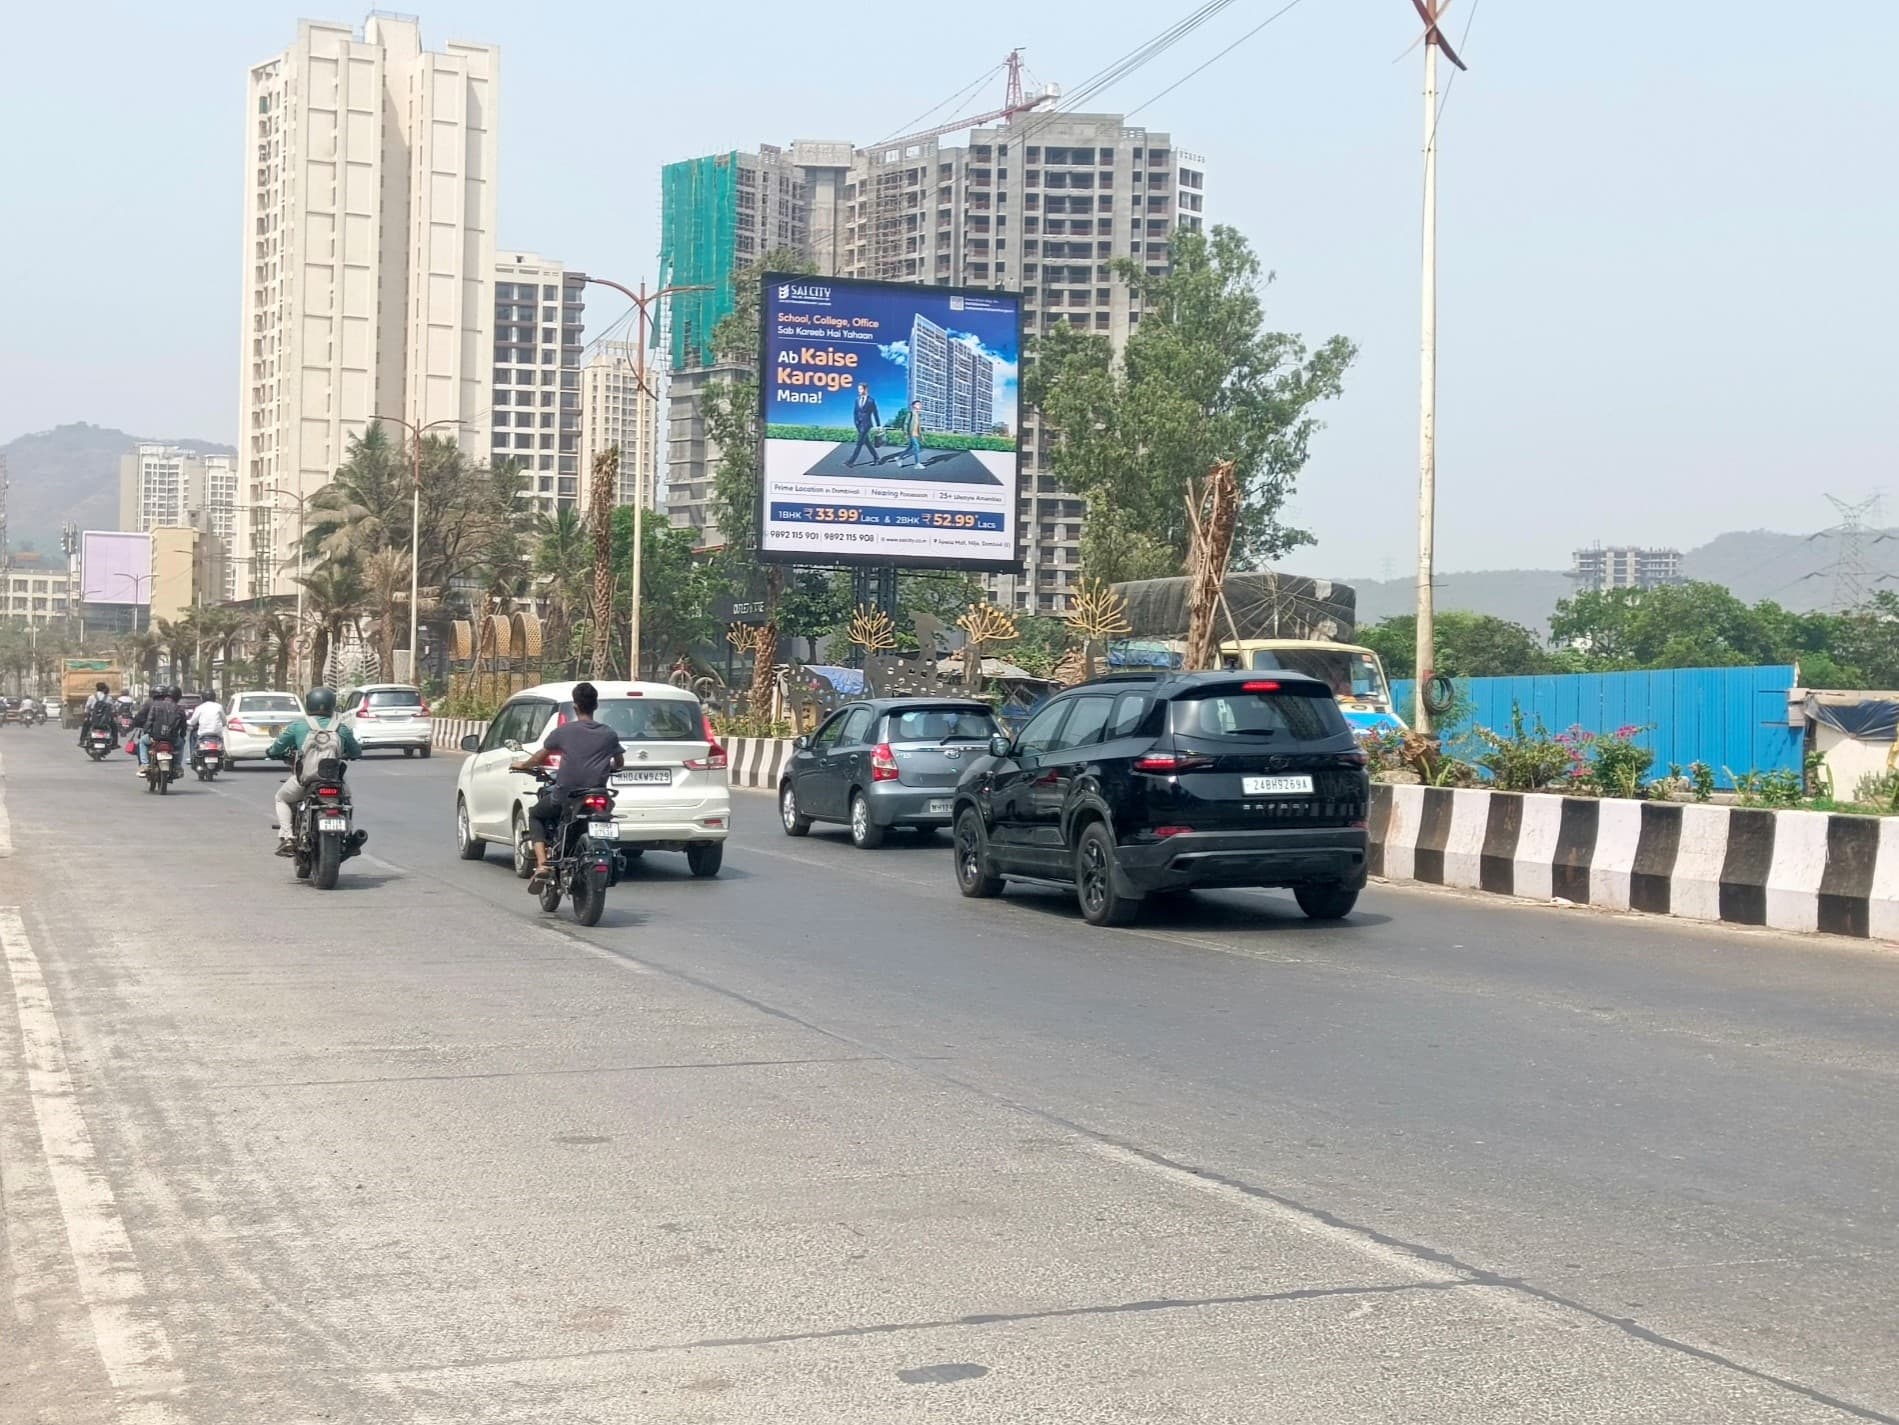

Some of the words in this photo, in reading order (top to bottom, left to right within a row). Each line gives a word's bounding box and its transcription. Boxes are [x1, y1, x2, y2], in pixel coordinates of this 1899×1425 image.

[809, 286, 831, 298] CITY
[778, 313, 811, 325] School,
[813, 315, 850, 328] College,
[852, 317, 880, 328] Office
[777, 326, 794, 335] Sab
[796, 327, 825, 337] Kareeb
[827, 329, 841, 338] Hai
[842, 330, 873, 340] Yahaan
[778, 350, 799, 364] Ab
[801, 347, 858, 367] Kaise
[777, 367, 854, 391] Karoge
[777, 389, 822, 404] Mana!
[774, 483, 793, 492] Prime
[795, 485, 824, 493] Location
[871, 488, 899, 498] Nearing
[939, 492, 952, 500] 25+
[778, 510, 801, 520] 1BHK
[860, 514, 880, 523] Lacs
[895, 516, 920, 525] 2BHK
[978, 520, 996, 529] Lacs
[770, 530, 790, 539] 9892
[792, 531, 803, 540] 115
[805, 532, 819, 540] 901
[824, 533, 844, 541] 9892
[846, 533, 856, 541] 115
[1254, 779, 1308, 791] 24BH9269A
